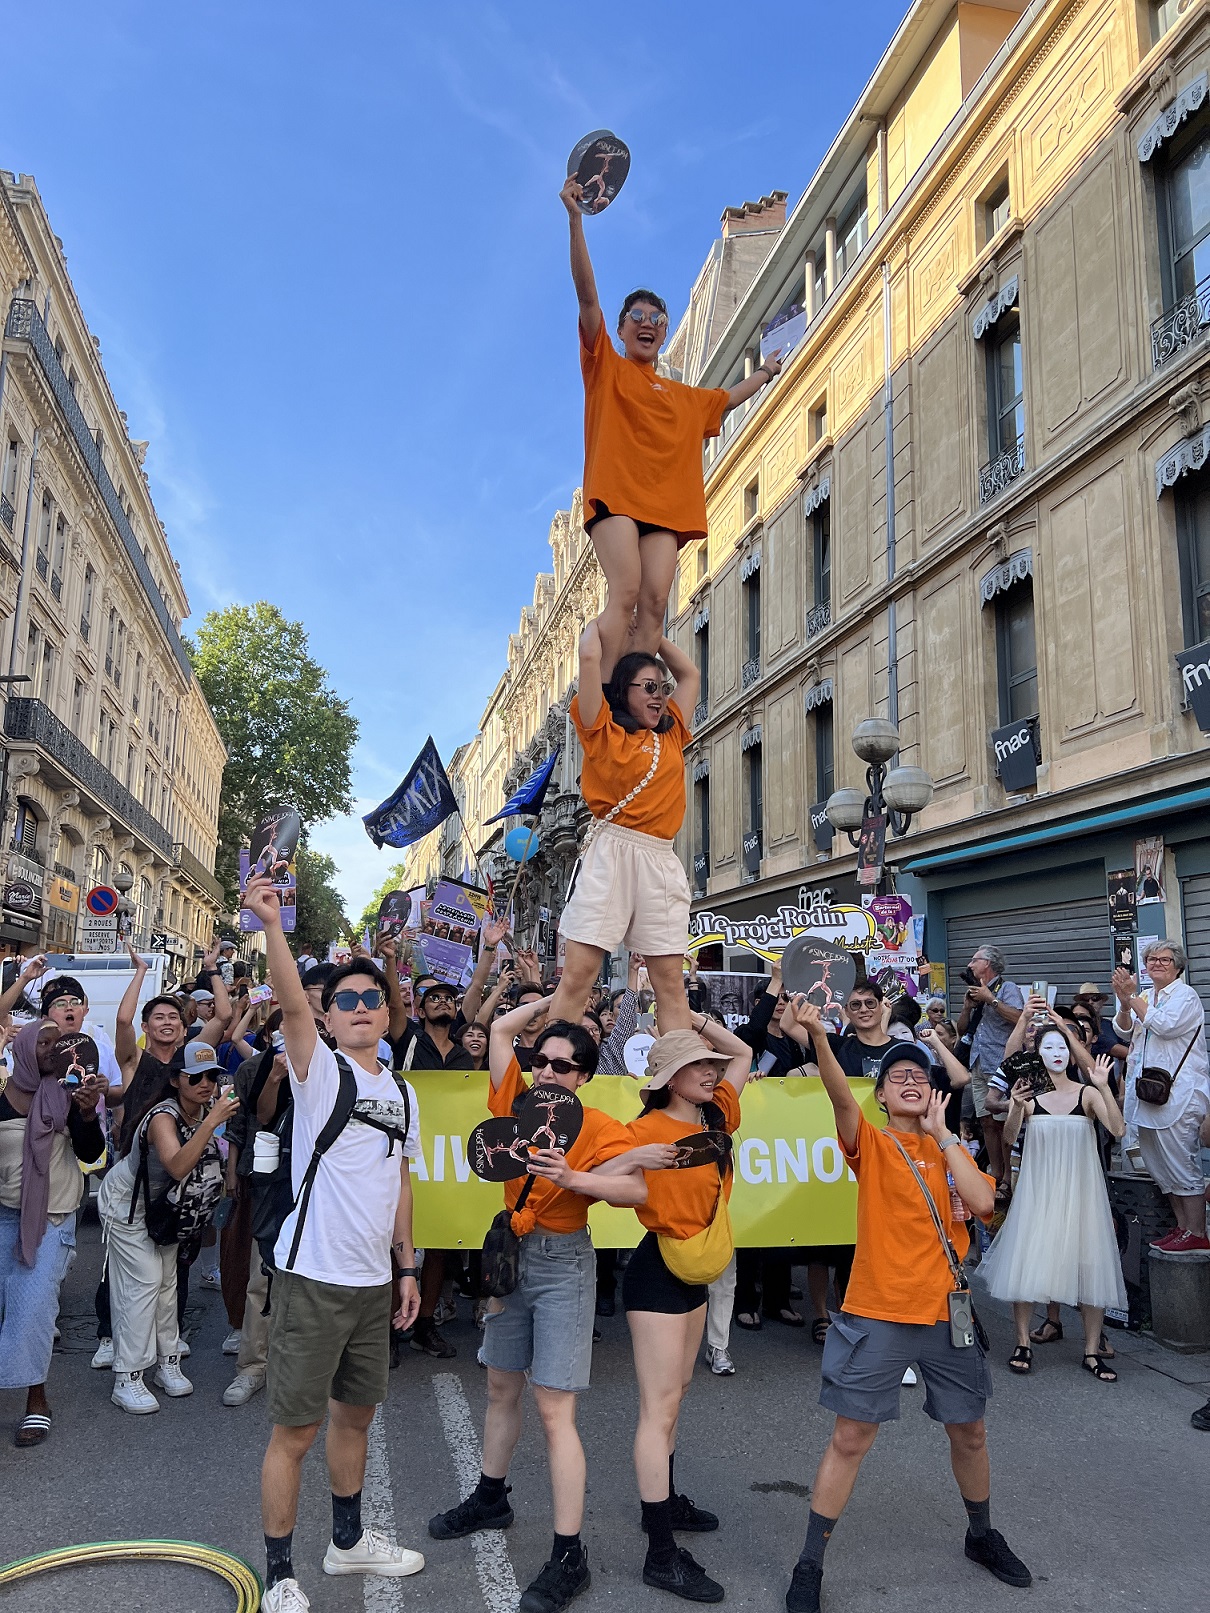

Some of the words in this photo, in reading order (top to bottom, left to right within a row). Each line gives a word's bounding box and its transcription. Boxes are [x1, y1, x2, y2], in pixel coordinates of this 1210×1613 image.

[1182, 658, 1210, 692] fn
[994, 728, 1030, 762] fnac
[744, 835, 759, 854] fnac
[694, 856, 706, 873] fnac
[798, 885, 832, 910] fnac
[702, 916, 728, 933] Le
[725, 919, 791, 944] projet
[783, 906, 845, 925] Rodin
[732, 1136, 857, 1184] GNO
